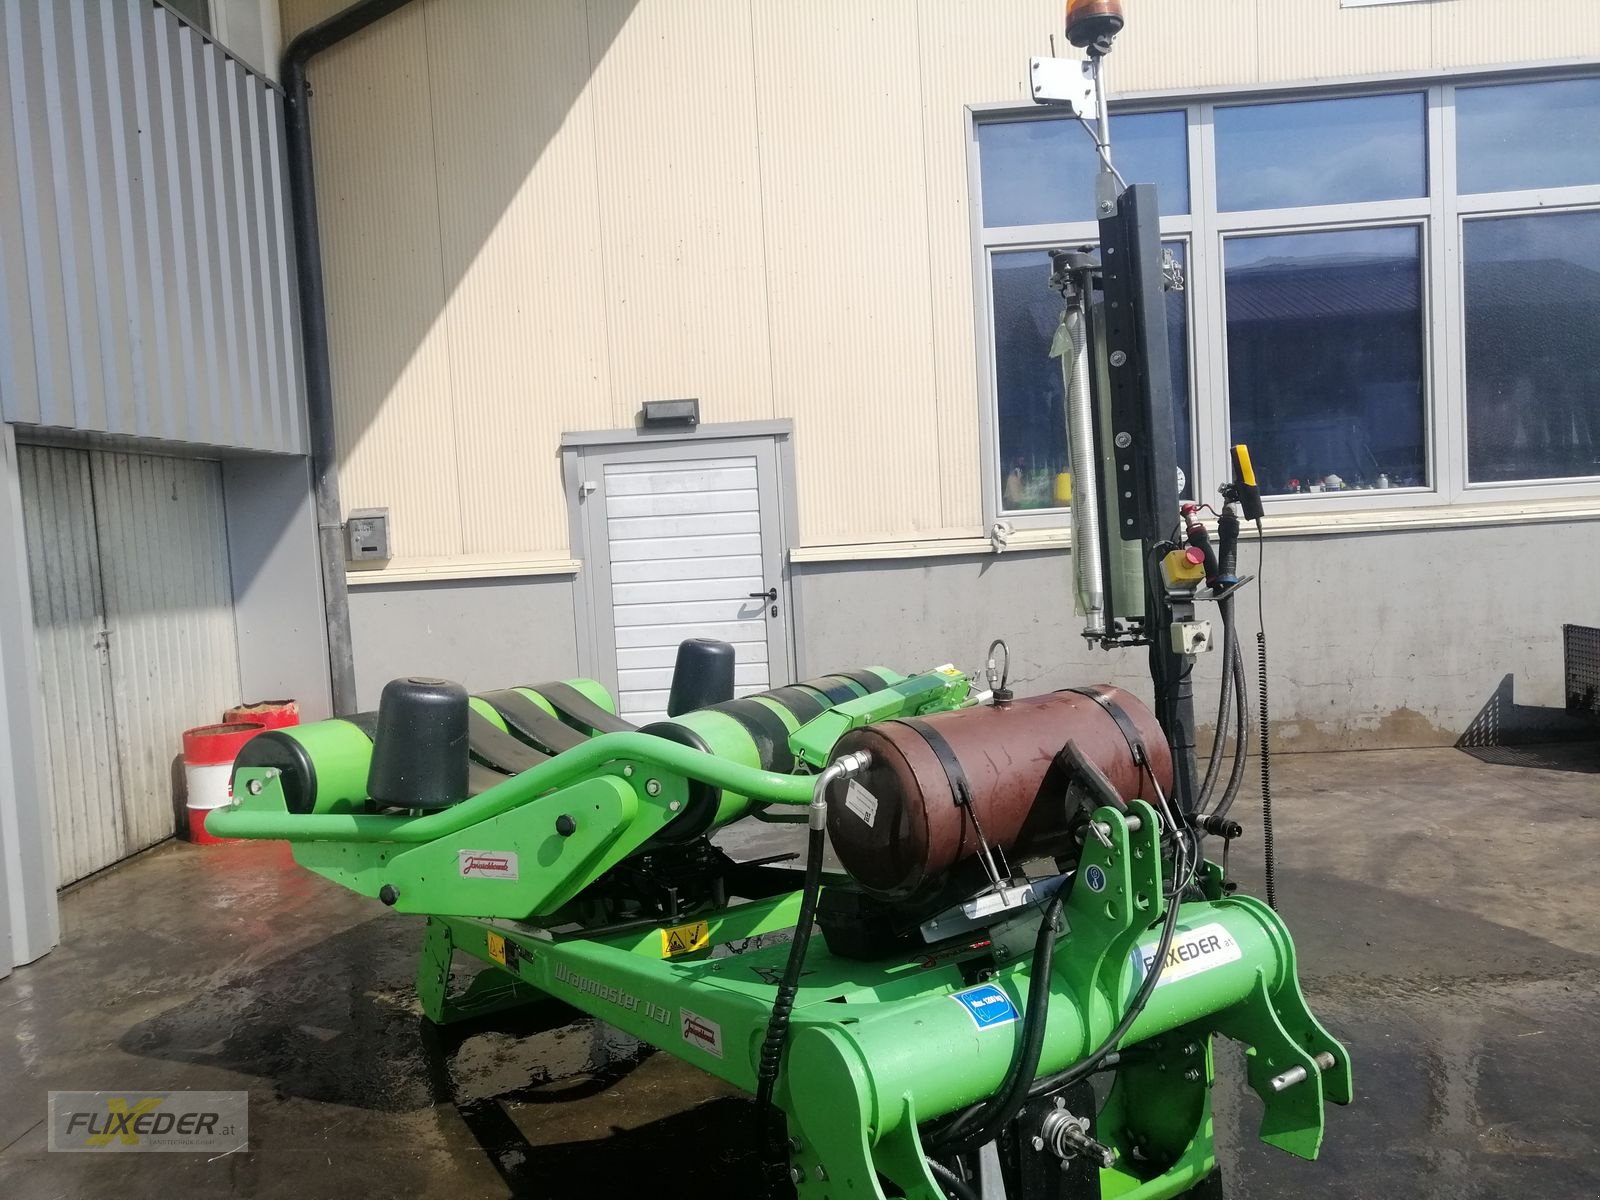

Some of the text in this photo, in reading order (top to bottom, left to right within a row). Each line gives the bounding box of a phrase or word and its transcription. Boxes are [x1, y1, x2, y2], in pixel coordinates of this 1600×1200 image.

[1143, 935, 1222, 974] FXEDER
[554, 961, 671, 1026] Wrapmaster 1131
